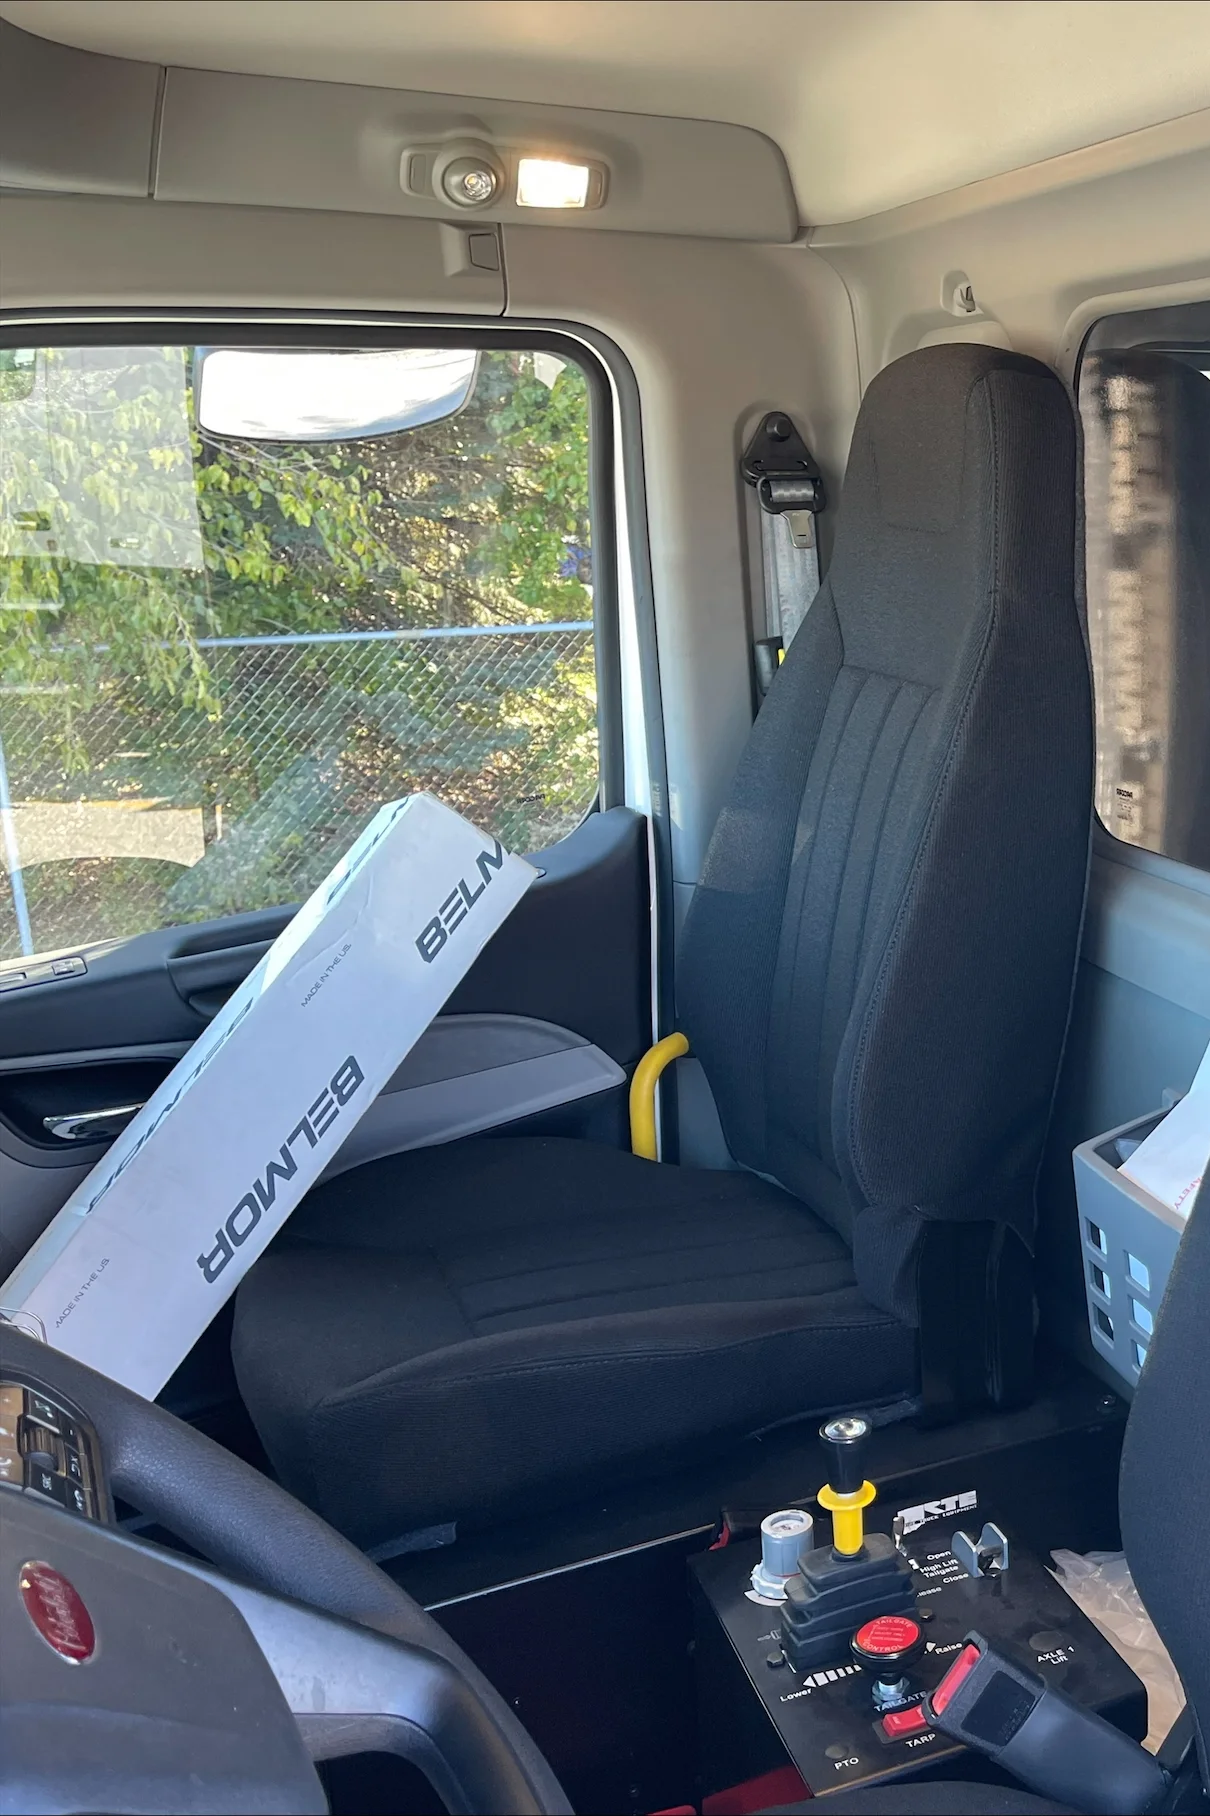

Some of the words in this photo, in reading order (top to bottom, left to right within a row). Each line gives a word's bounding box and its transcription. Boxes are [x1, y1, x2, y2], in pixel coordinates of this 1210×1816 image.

[301, 981, 323, 1007] MADE
[319, 972, 329, 982] IN
[326, 957, 342, 972] THE
[197, 1055, 365, 1284] BELMOR
[1174, 1177, 1202, 1209] AFETY
[73, 1291, 84, 1302] IN
[81, 1272, 98, 1290] THE
[942, 1505, 977, 1517] EQUIPMENT
[926, 1550, 951, 1560] Open
[920, 1563, 941, 1573] High
[942, 1558, 959, 1567] Lift
[923, 1565, 959, 1578] Tailgate
[943, 1573, 969, 1584] Close
[875, 1619, 913, 1628] TAILGATE
[863, 1640, 904, 1653] CONTROL
[935, 1643, 963, 1655] Raise
[1037, 1649, 1065, 1662] AXLE
[1050, 1655, 1068, 1665] Lift
[780, 1688, 812, 1702] Lower
[874, 1690, 928, 1711] TAILGATE
[905, 1733, 936, 1748] TARP
[834, 1757, 860, 1770] PTO
